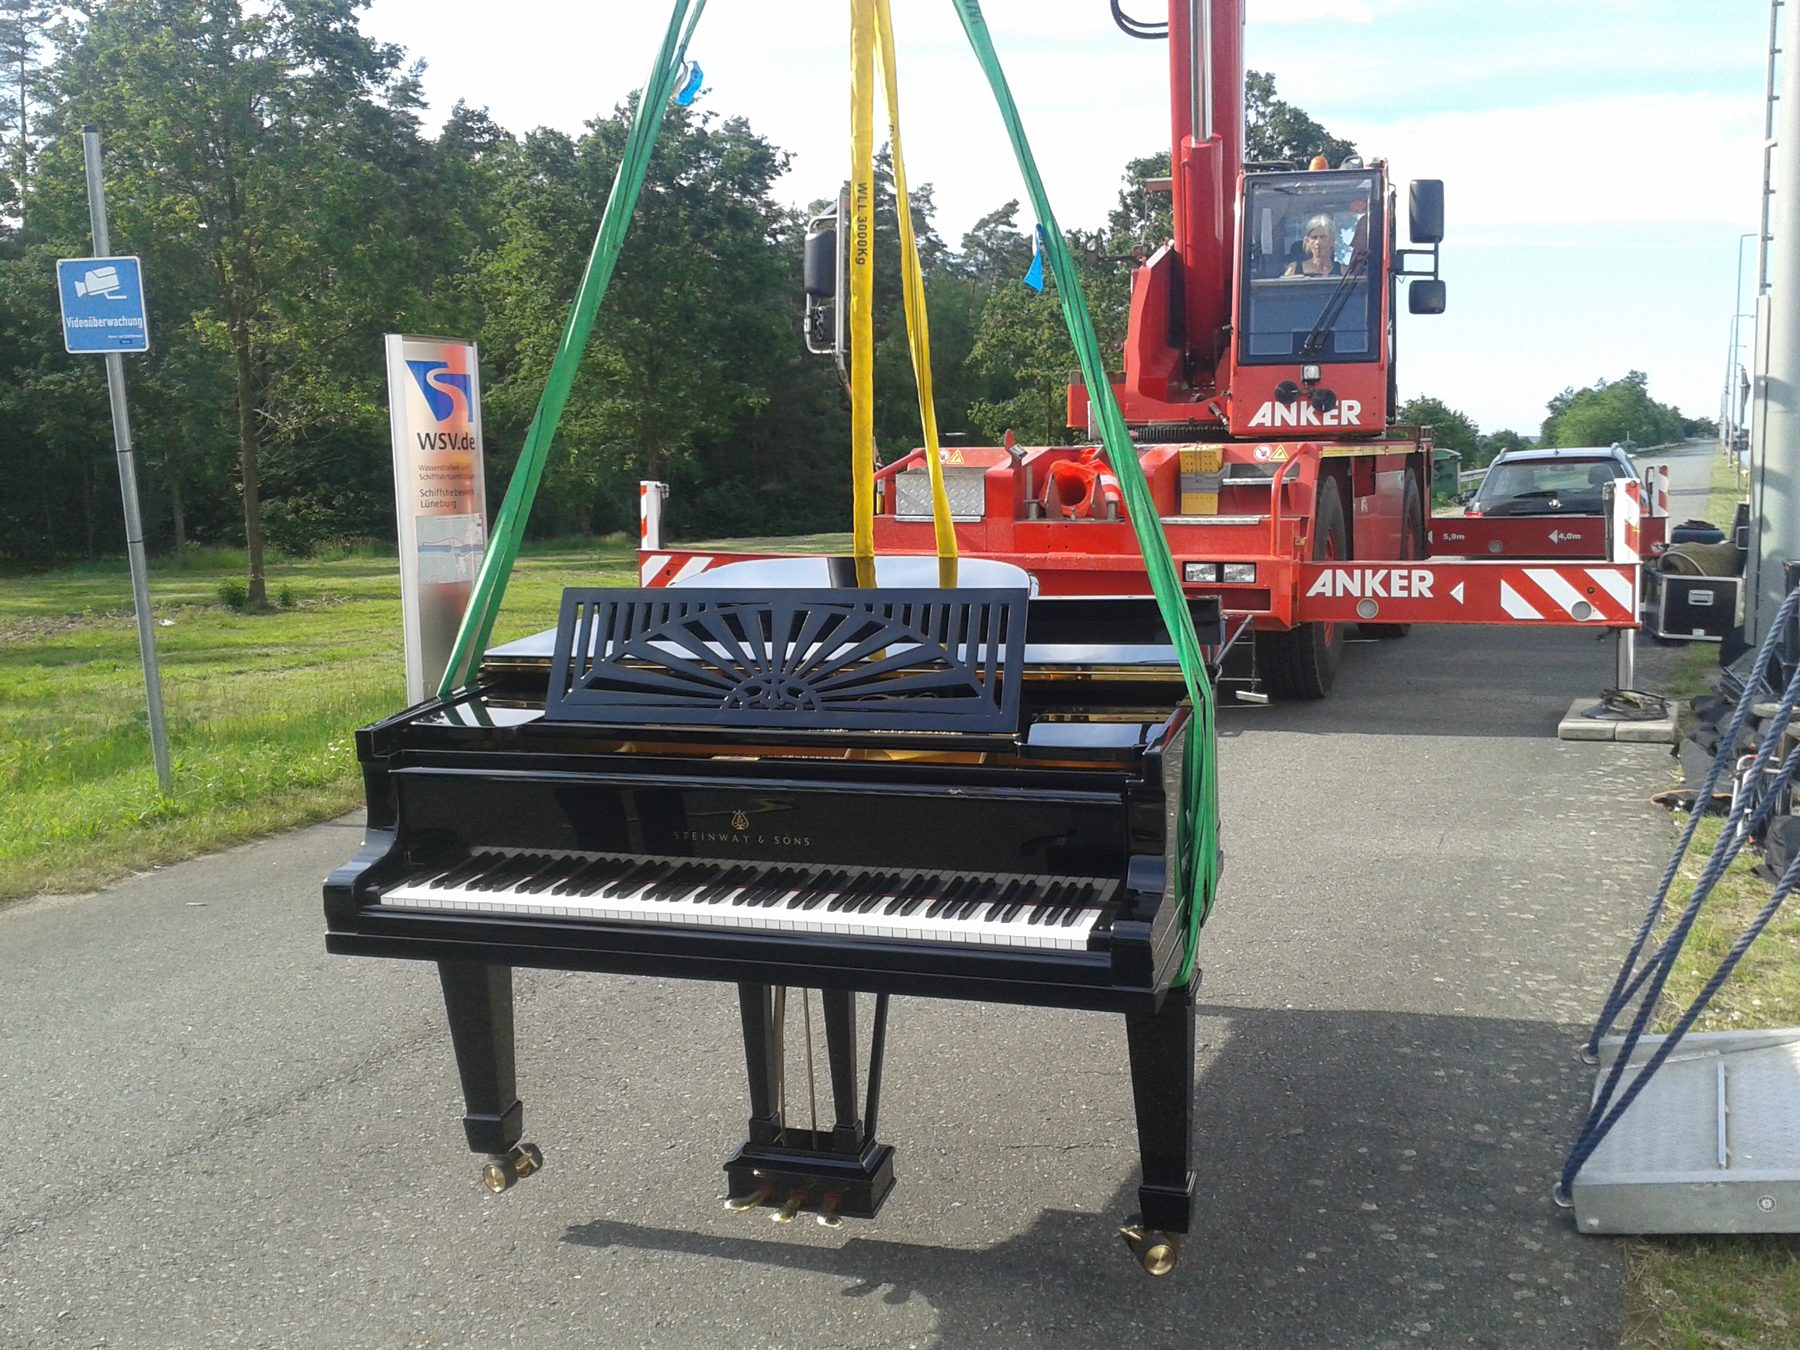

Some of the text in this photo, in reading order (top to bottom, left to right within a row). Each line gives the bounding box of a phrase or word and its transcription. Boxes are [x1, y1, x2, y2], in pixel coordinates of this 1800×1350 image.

[857, 182, 868, 212] WLL
[65, 315, 143, 329] Videoüberwachung
[1247, 400, 1362, 427] ANKER
[416, 432, 476, 451] WSV.de
[420, 500, 457, 510] Lüneburg
[1305, 569, 1435, 598] ANKER
[673, 831, 810, 846] STEINWAY & SONS
